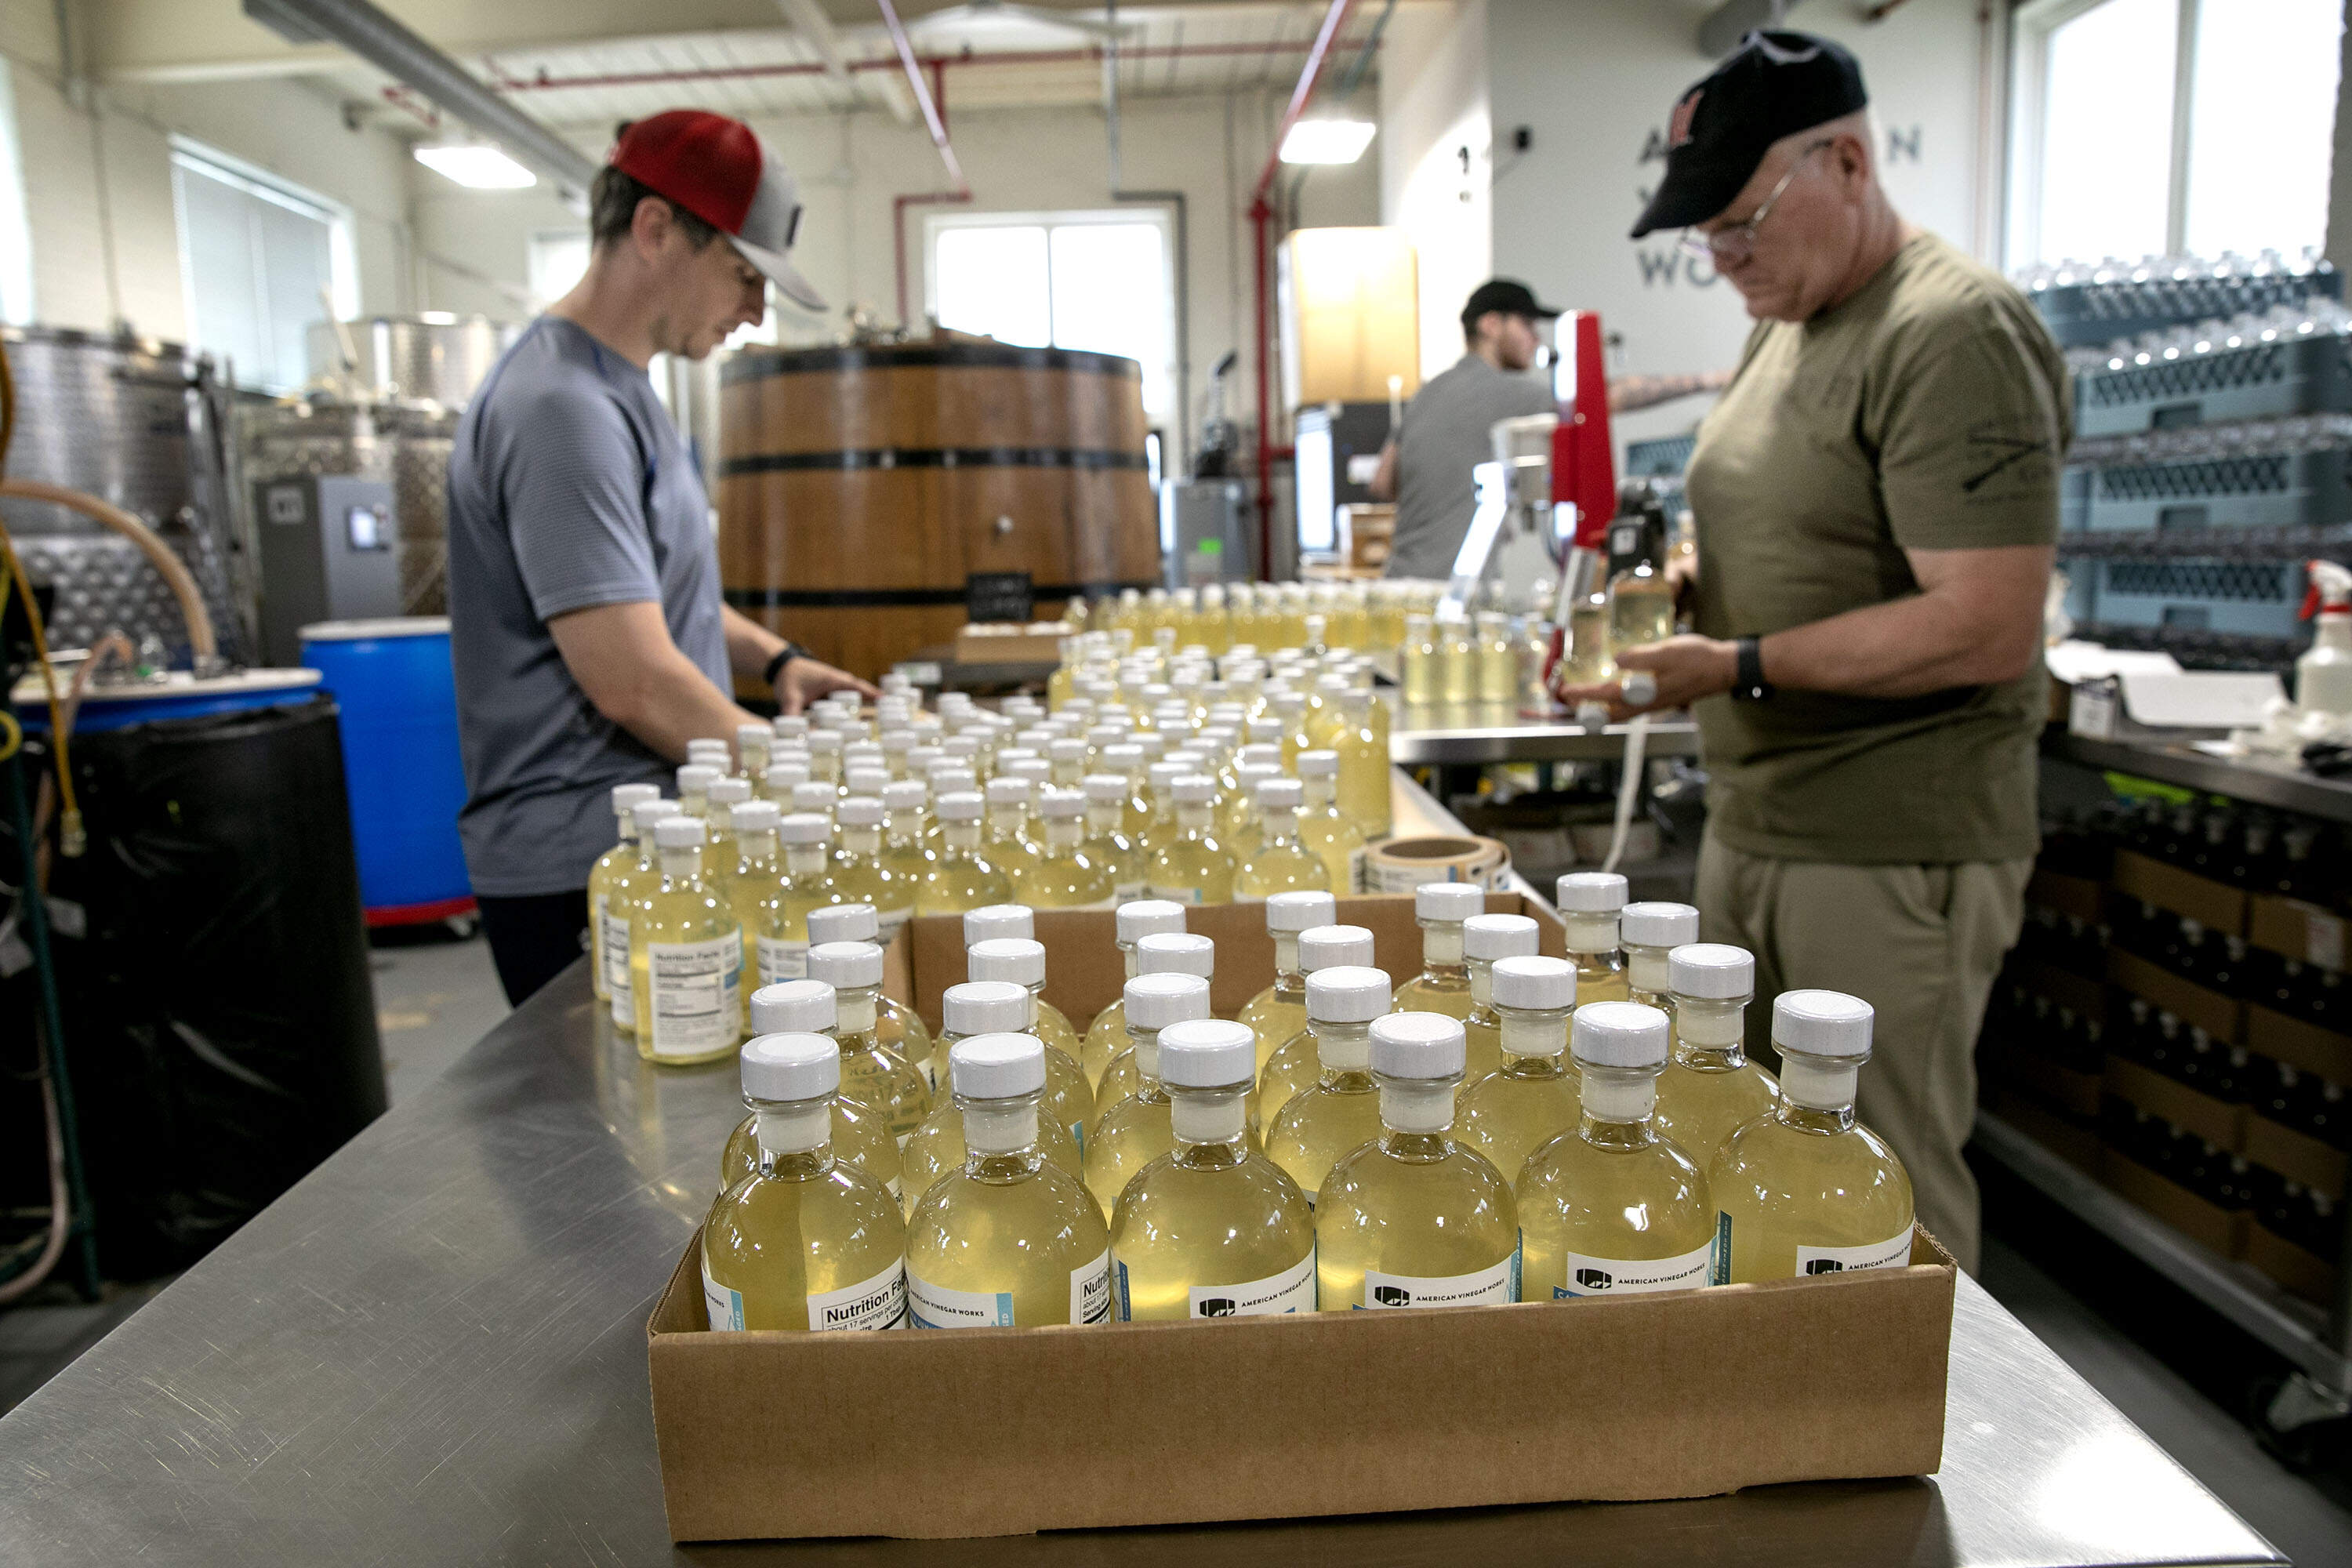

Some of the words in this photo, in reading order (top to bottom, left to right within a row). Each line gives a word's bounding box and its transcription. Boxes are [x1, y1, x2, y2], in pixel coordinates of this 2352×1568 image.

[1849, 1260, 1883, 1270] AMERICAN
[1884, 1249, 1904, 1262] VINEGAR
[1660, 1271, 1688, 1282] VINEGAR
[1689, 1262, 1705, 1276] WORKS
[1242, 1294, 1278, 1308] AMERICAN
[1279, 1281, 1301, 1296] VINEGAR
[1458, 1288, 1486, 1298] VINEGAR
[1487, 1278, 1505, 1290] WORKS
[827, 1291, 889, 1323] Nutrition
[931, 1301, 956, 1314] VINEGAR
[958, 1308, 984, 1317] WORKS
[1083, 1303, 1101, 1318] Serving
[859, 1310, 884, 1326] servings
